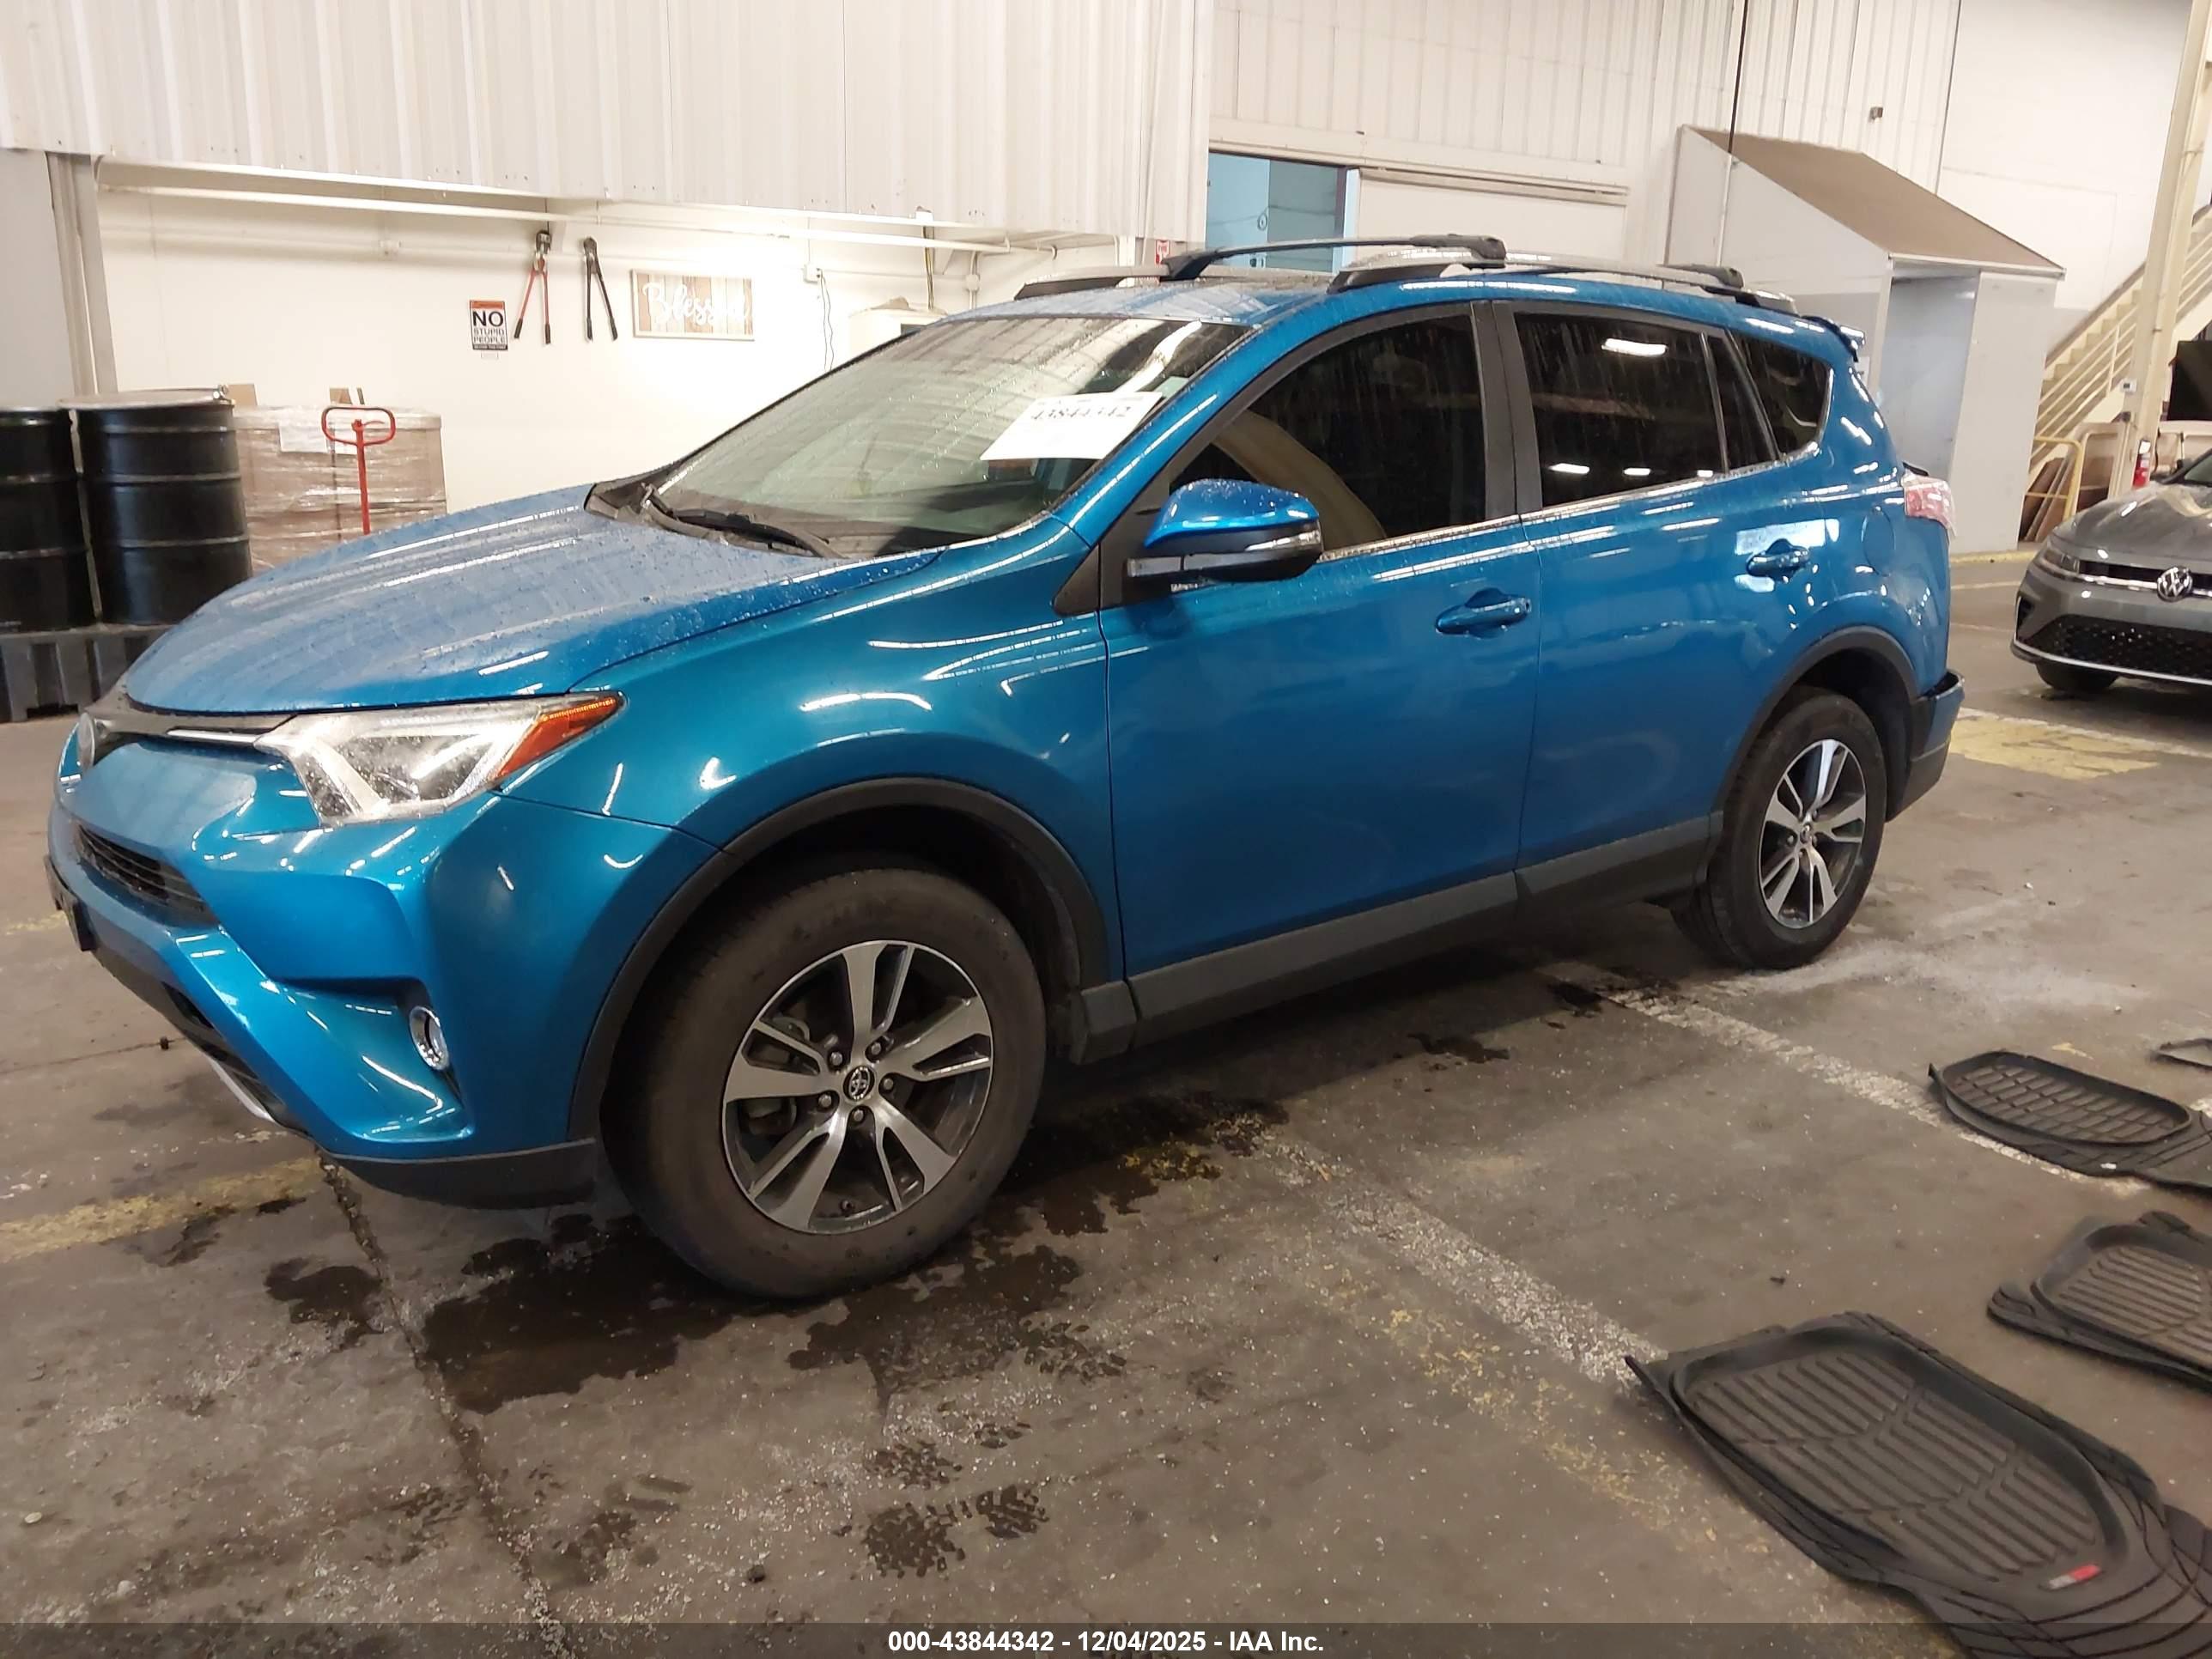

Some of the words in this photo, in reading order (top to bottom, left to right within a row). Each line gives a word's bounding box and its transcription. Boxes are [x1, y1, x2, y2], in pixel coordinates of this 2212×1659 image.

[641, 282, 753, 326] Blessd
[472, 310, 504, 327] NO
[473, 327, 505, 336] STUPID
[473, 336, 506, 344] PEOPLE
